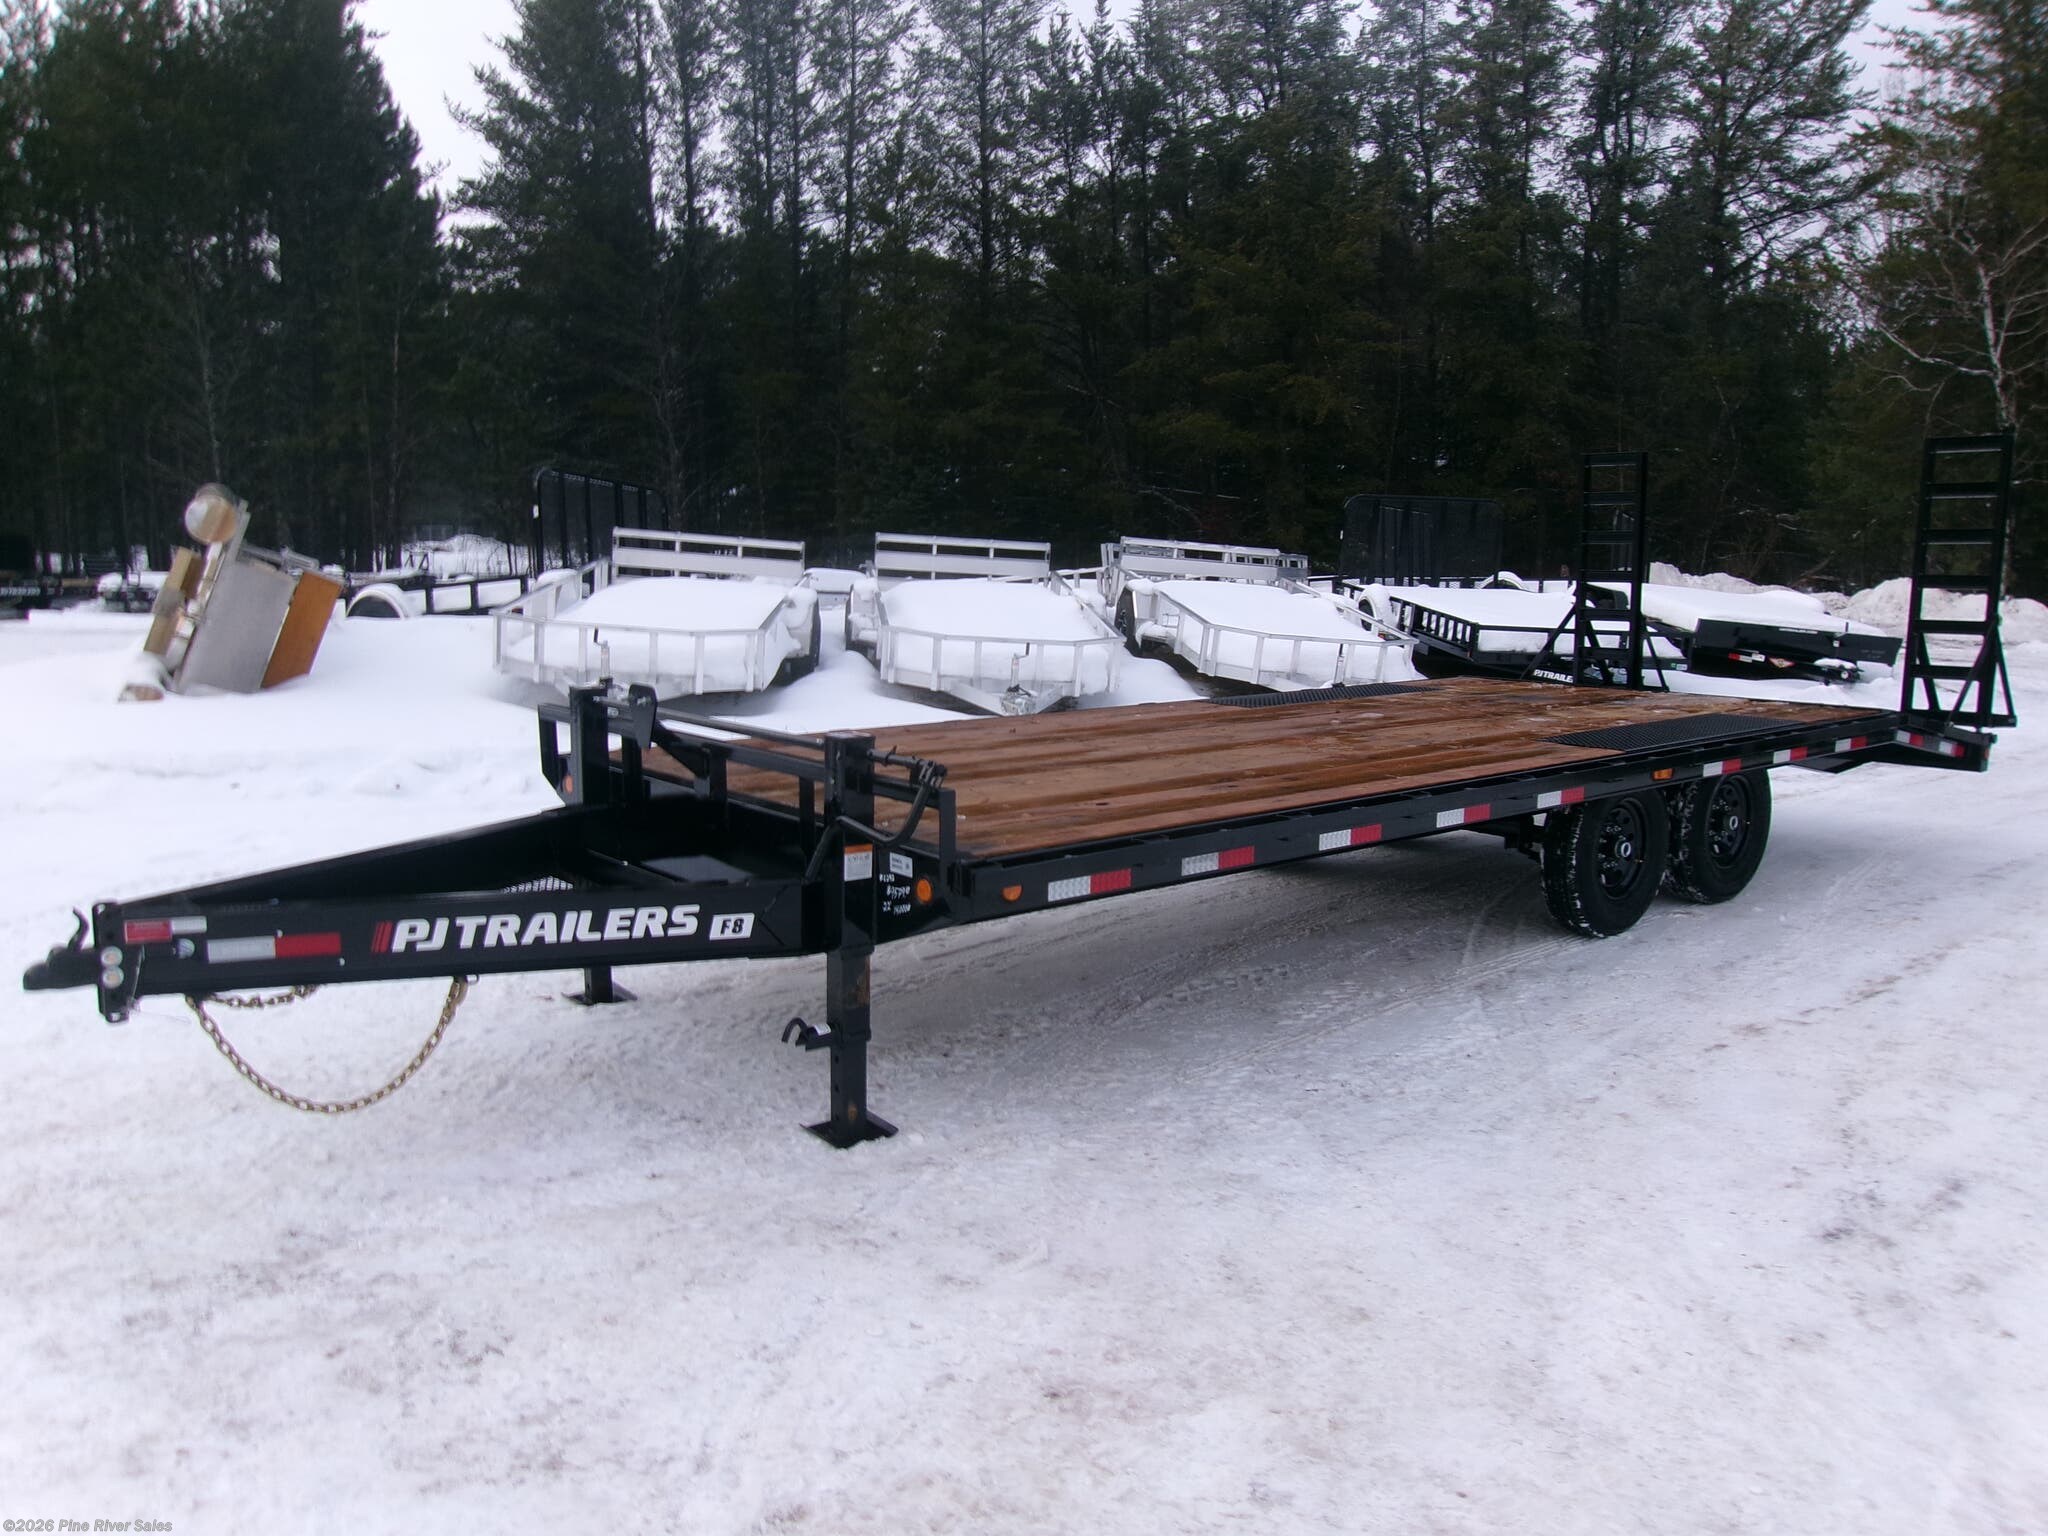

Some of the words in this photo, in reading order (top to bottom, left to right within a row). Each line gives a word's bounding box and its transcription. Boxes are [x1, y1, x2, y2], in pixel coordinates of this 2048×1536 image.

[392, 918, 449, 953] PJ
[455, 904, 701, 949] TRAILERS
[720, 918, 745, 936] F8
